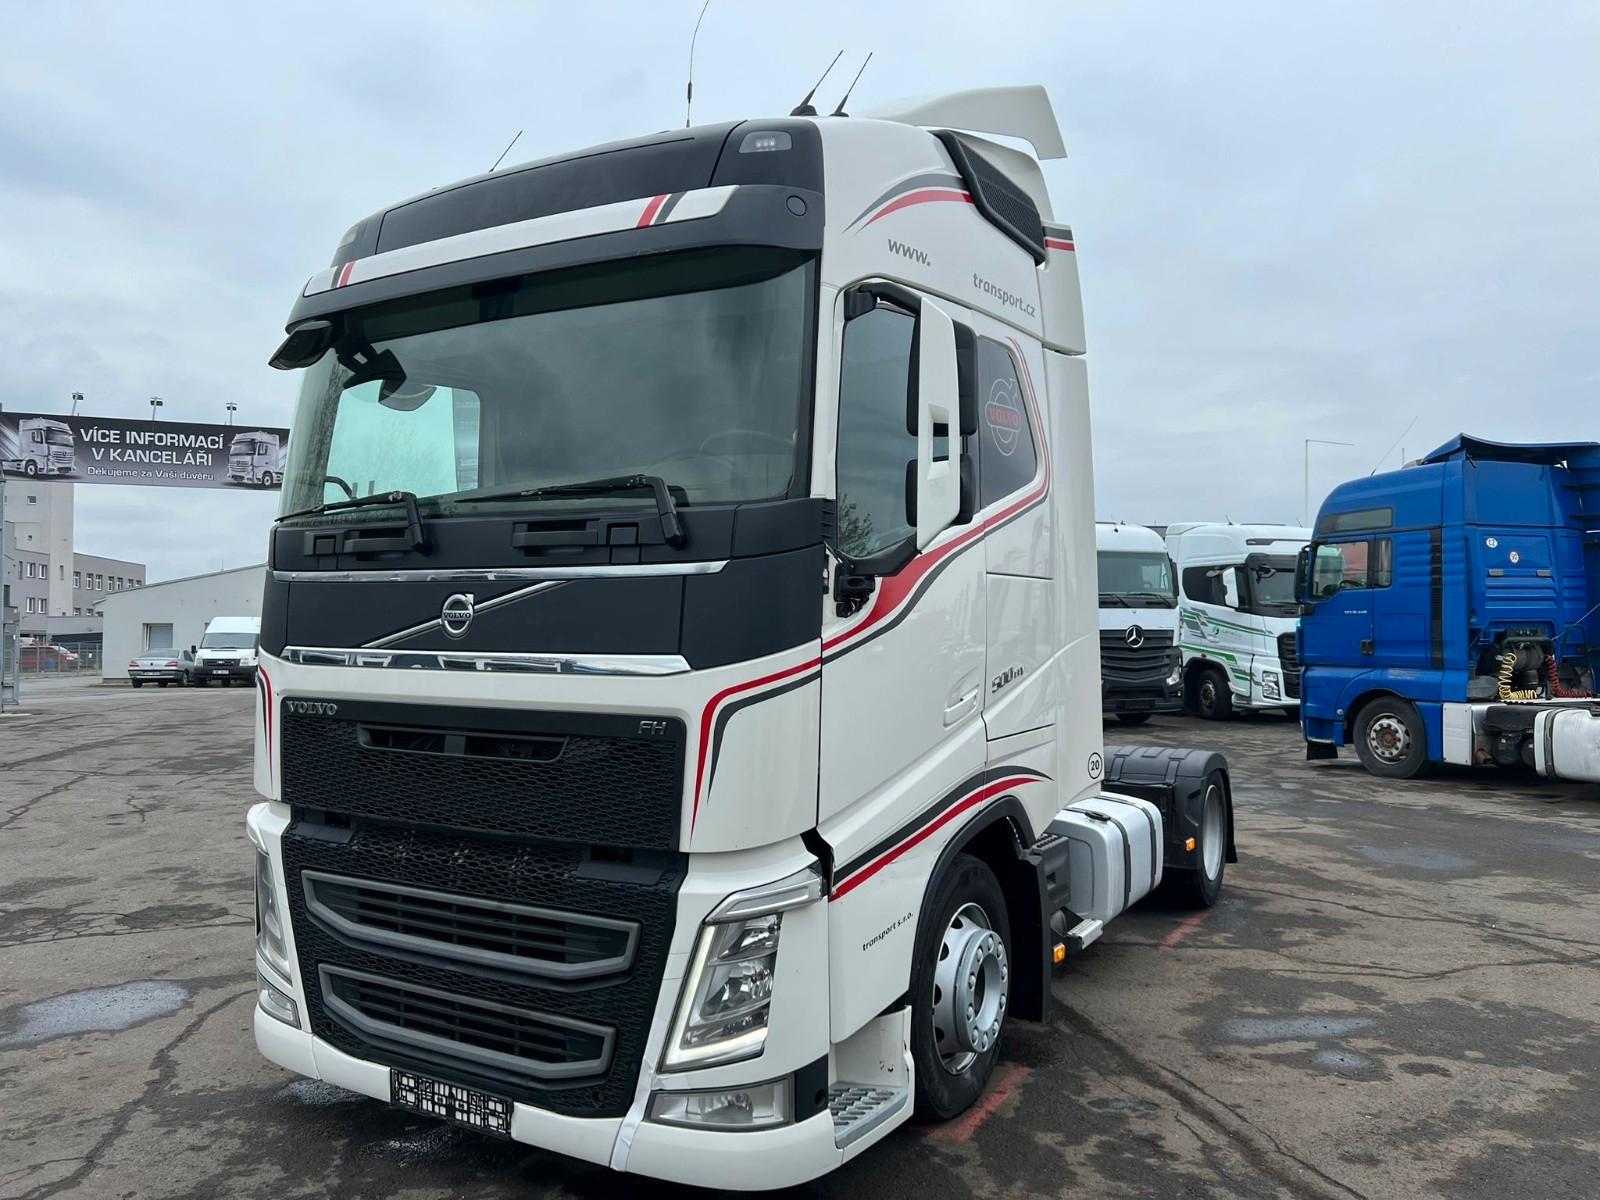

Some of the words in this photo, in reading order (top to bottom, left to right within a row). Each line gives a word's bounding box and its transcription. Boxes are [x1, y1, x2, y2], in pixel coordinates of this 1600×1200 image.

[888, 239, 931, 266] www.
[973, 273, 1035, 317] transport.cz
[80, 426, 121, 443] VÍCE
[126, 431, 224, 449] INFORMACÍ
[91, 447, 105, 461] V
[110, 448, 212, 466] KANCELÁŘI
[155, 469, 177, 478] Vaši
[285, 700, 338, 715] VOLVO
[638, 720, 667, 735] FH
[1090, 760, 1100, 771] 20
[862, 922, 896, 951] transport
[897, 912, 913, 926] s.r.o.
